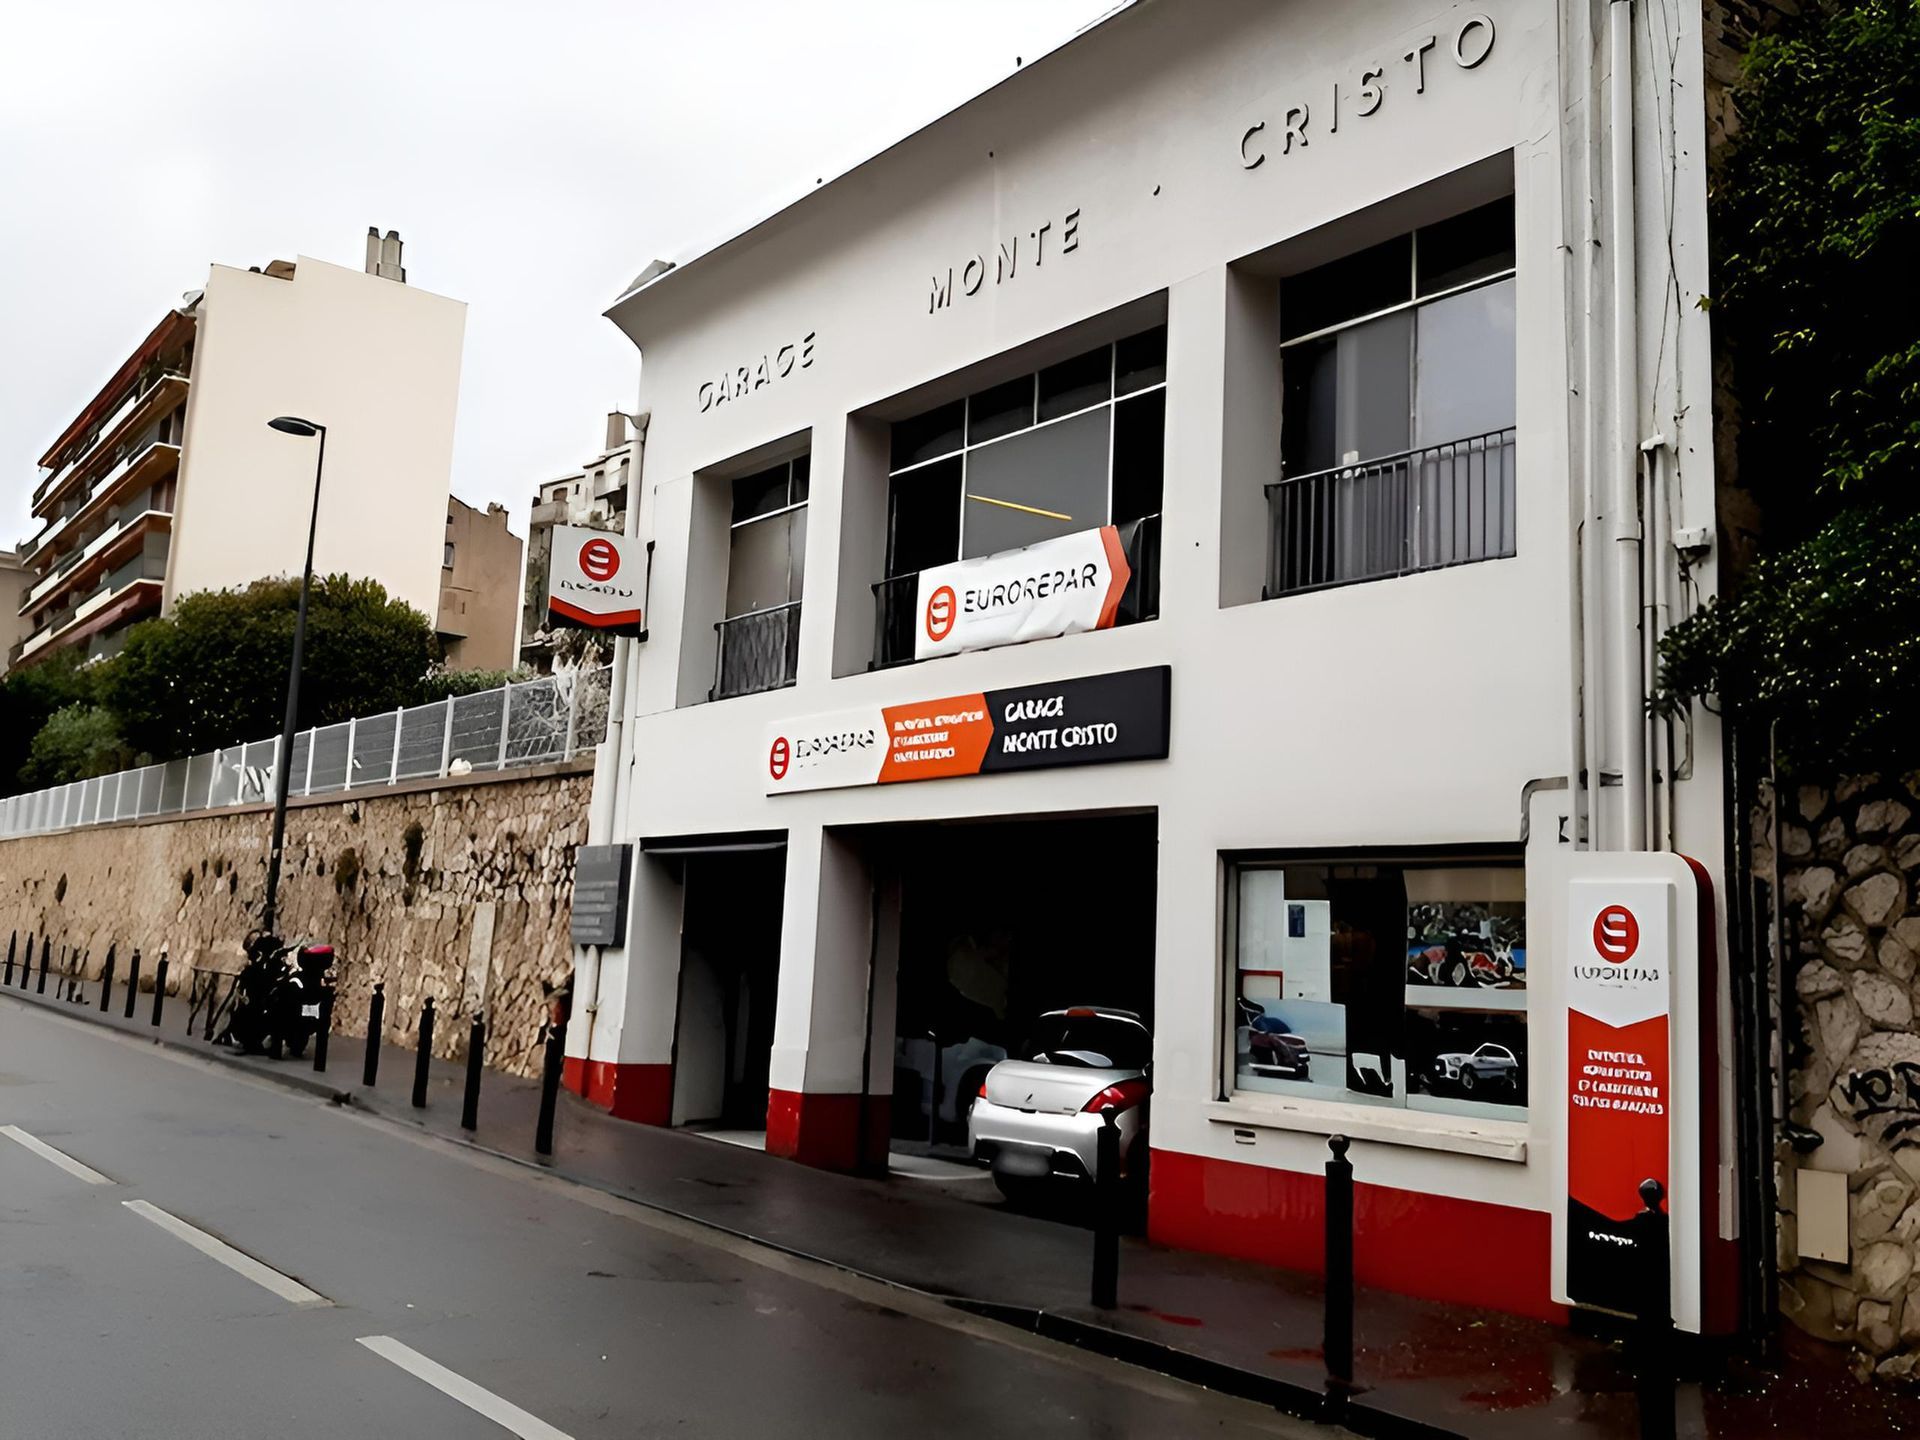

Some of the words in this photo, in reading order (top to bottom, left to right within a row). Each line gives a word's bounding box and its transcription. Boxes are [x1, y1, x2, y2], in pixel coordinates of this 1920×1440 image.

[928, 207, 1081, 315] MONTE
[1240, 12, 1496, 170] CRISTO
[963, 562, 1098, 613] EUROREPAR
